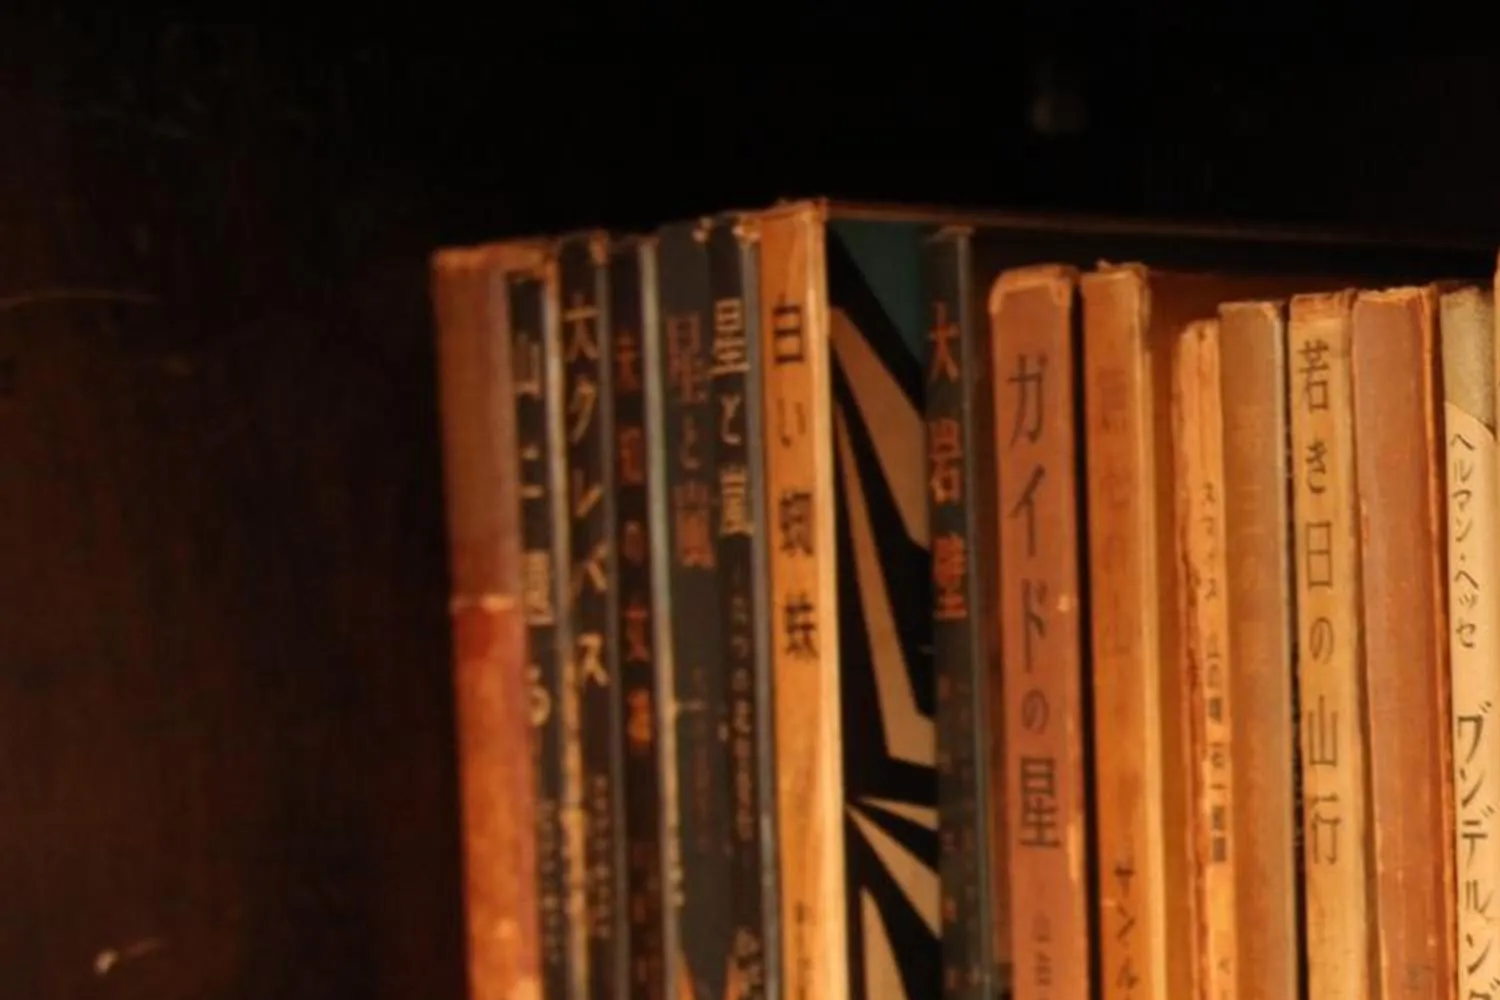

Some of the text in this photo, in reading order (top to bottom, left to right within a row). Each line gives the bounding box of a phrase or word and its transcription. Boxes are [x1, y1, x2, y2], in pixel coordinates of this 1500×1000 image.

[1450, 432, 1480, 651] ヘルマン・ヘッセ
